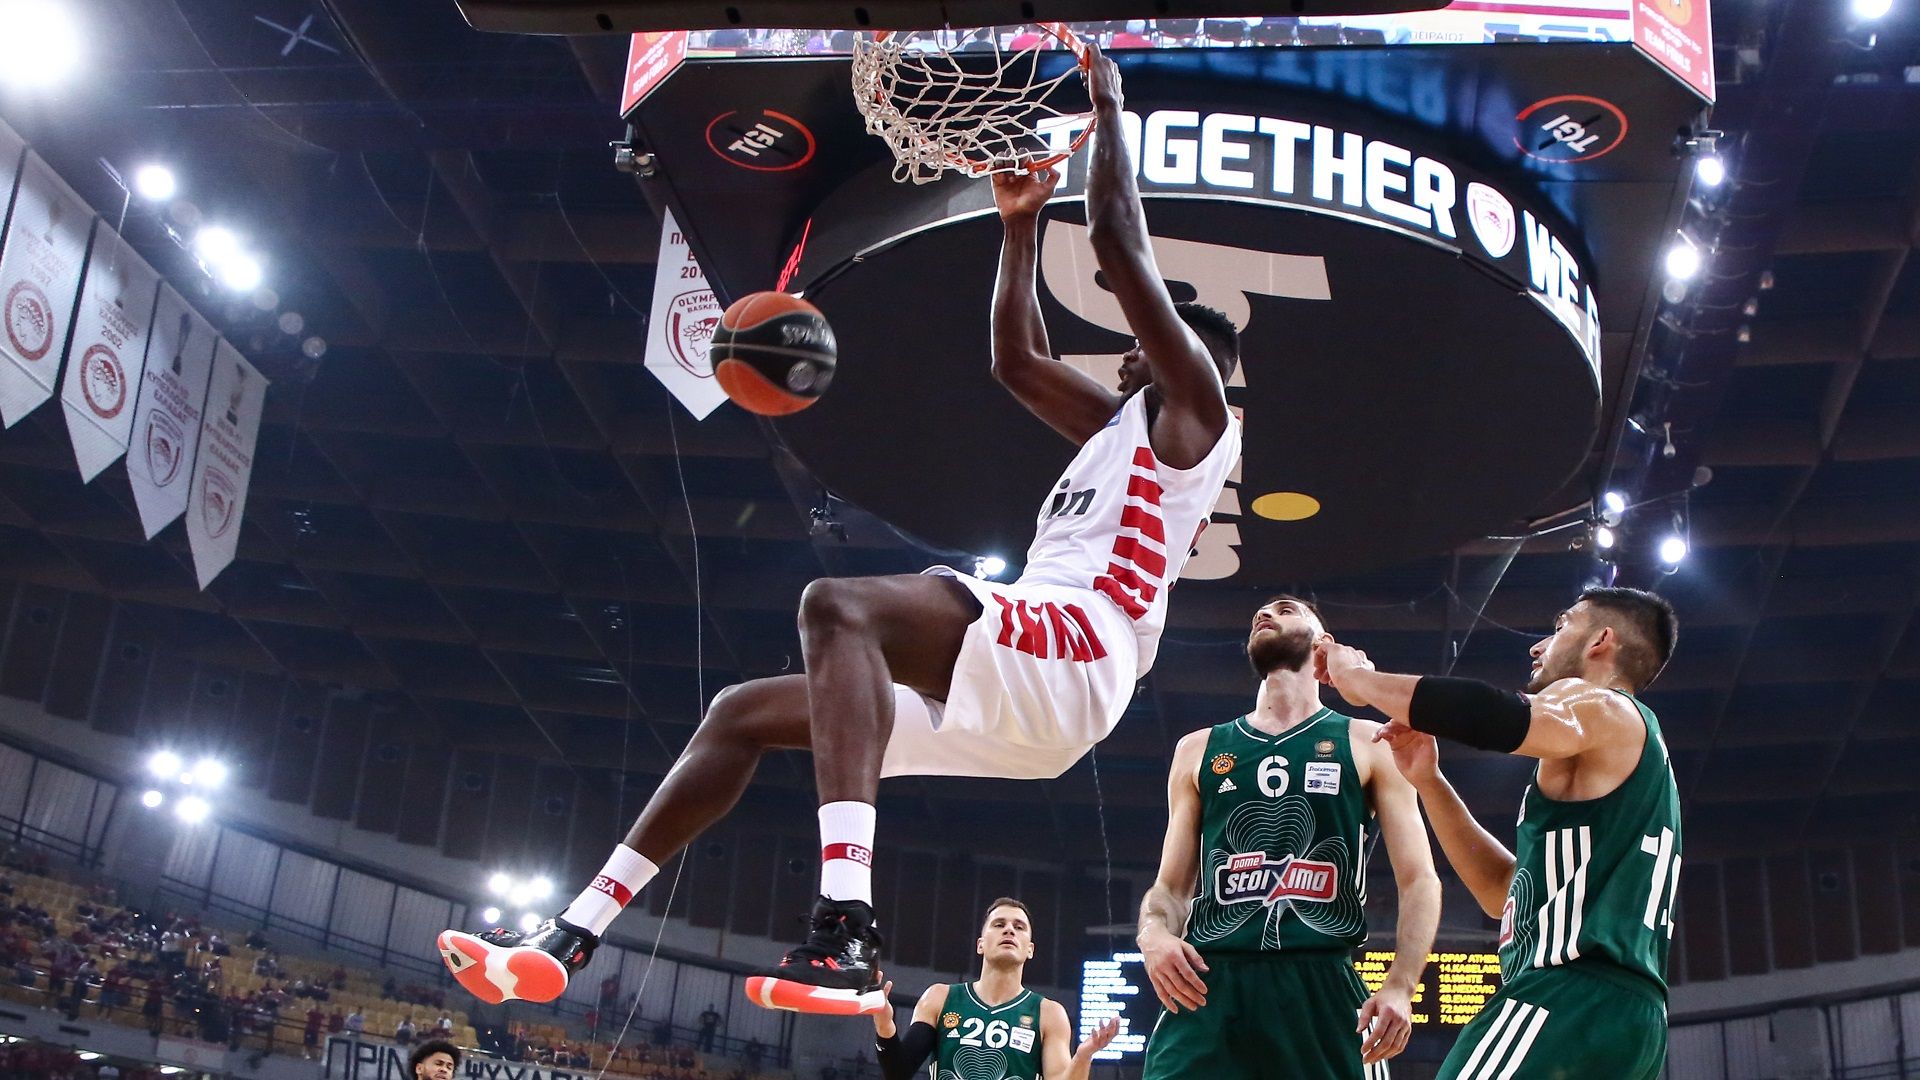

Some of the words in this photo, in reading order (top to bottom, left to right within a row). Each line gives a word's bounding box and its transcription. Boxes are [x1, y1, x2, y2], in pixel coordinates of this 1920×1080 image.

[678, 295, 717, 308] OLYMP
[687, 304, 722, 313] BASKET
[1257, 755, 1290, 798] 6
[1233, 857, 1260, 870] pame
[1468, 954, 1499, 964] ATHEN
[960, 1017, 1010, 1049] 26
